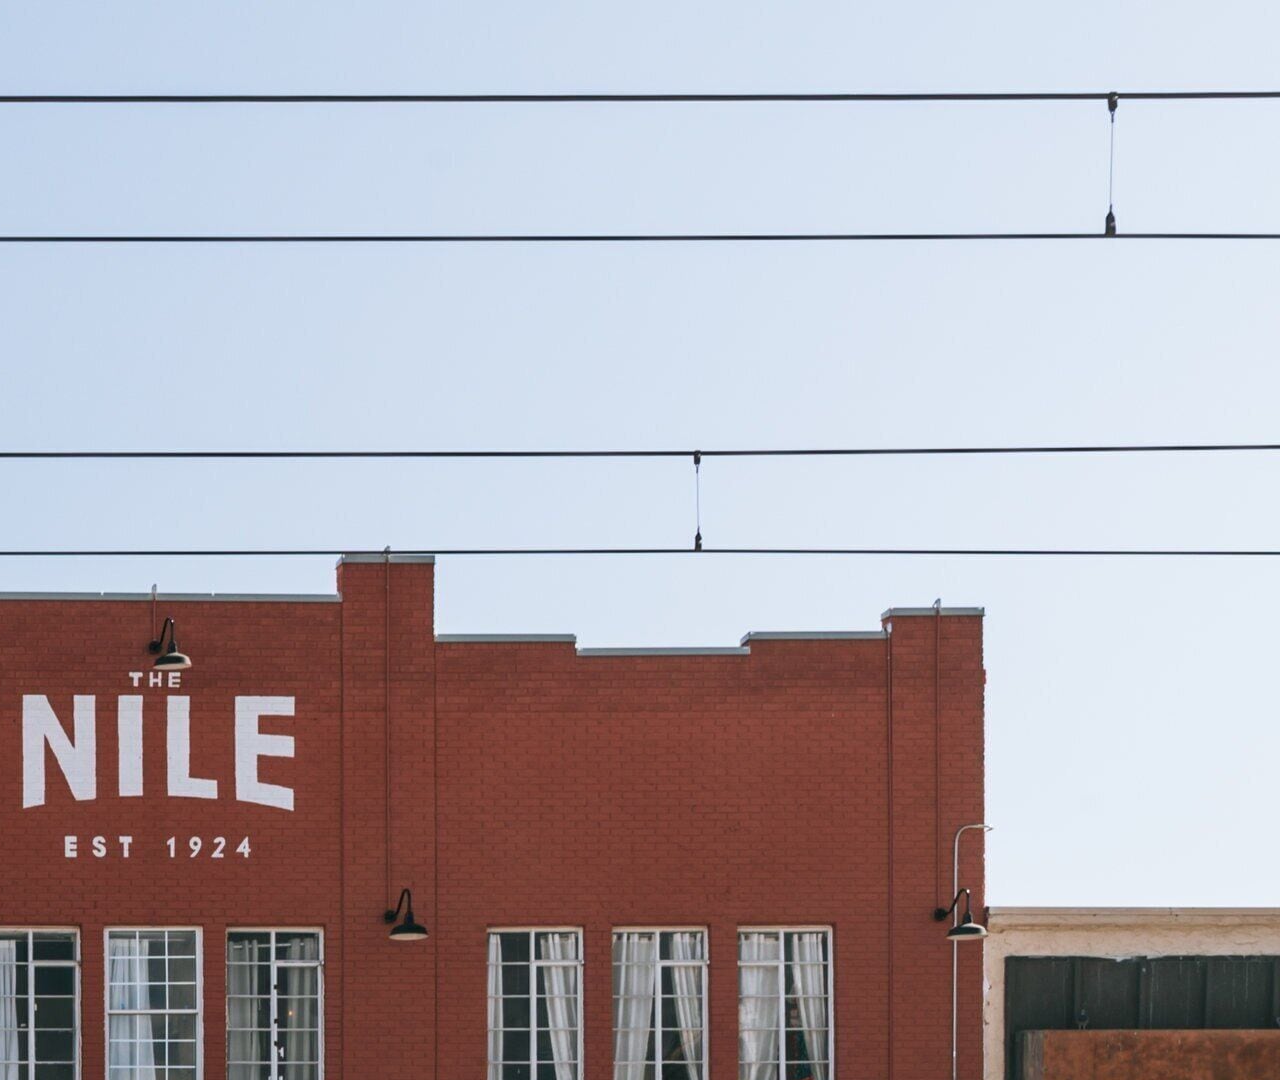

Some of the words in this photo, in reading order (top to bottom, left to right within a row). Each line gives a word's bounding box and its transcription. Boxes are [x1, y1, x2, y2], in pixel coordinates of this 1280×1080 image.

[129, 671, 182, 688] THE
[22, 694, 295, 811] NILE
[65, 836, 133, 858] EST
[166, 836, 251, 858] 1924
